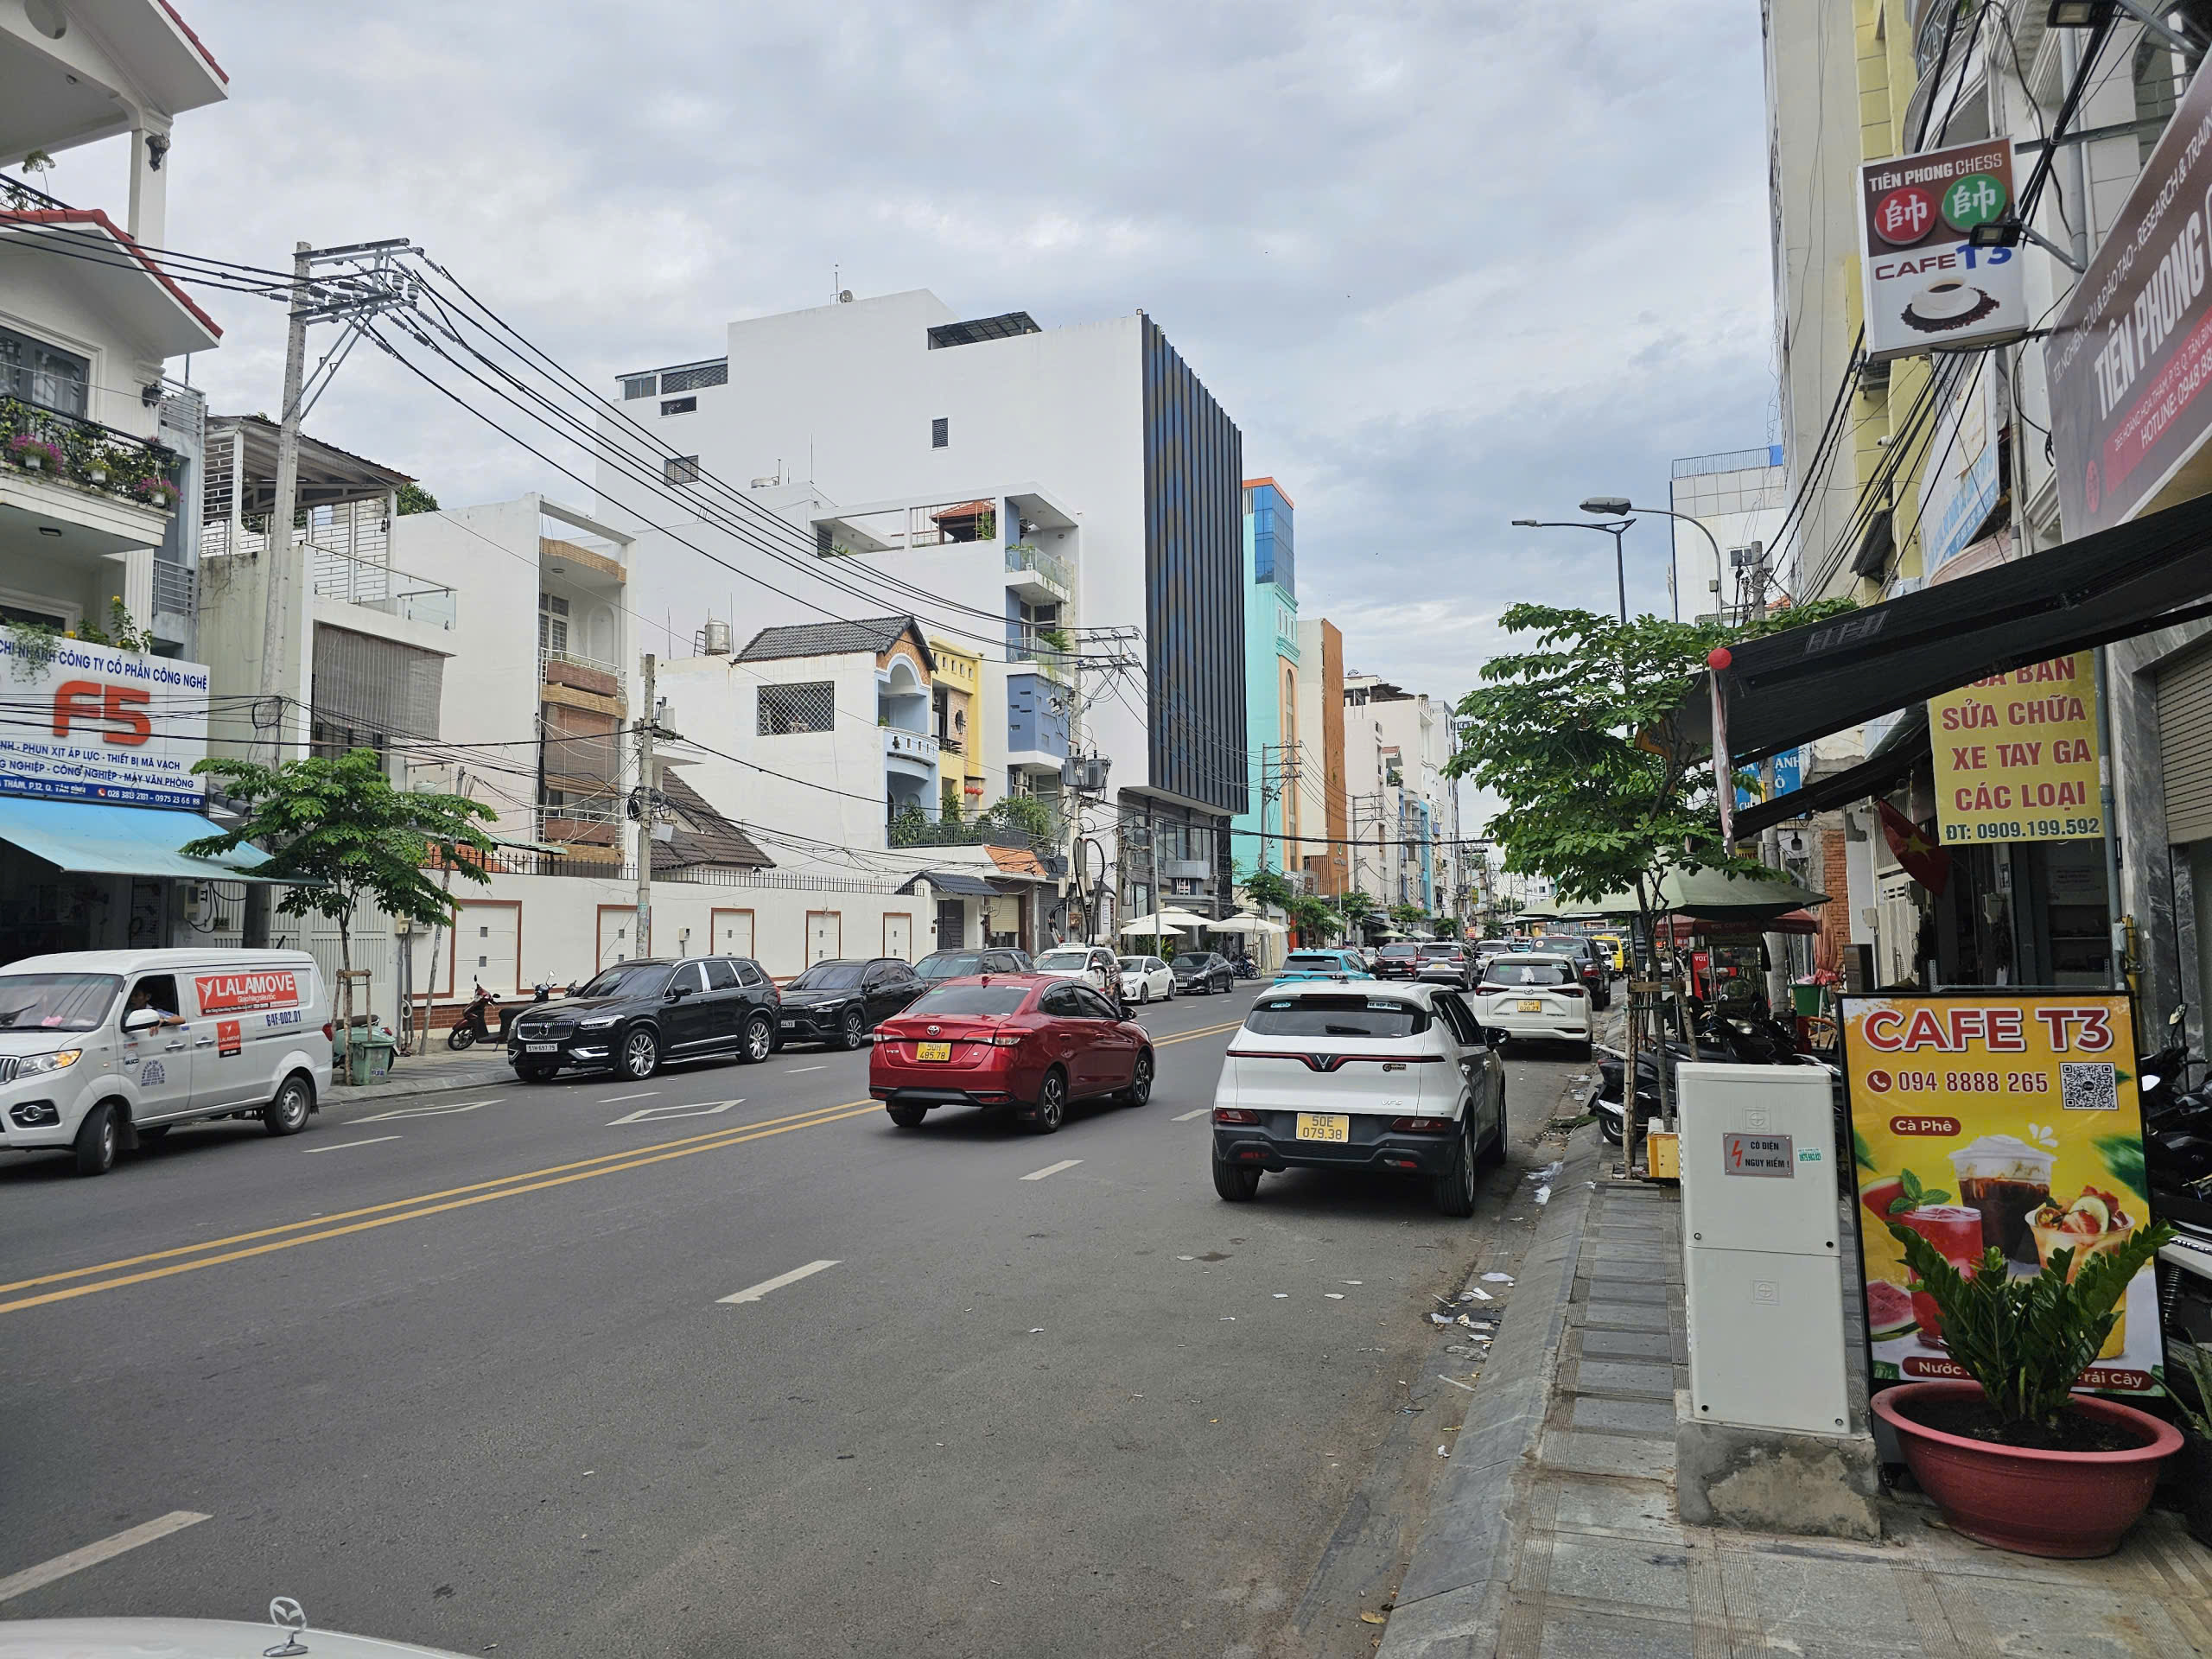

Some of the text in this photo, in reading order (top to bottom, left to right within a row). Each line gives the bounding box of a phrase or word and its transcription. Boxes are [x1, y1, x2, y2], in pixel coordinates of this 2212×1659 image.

[1869, 153, 2003, 193] TIÊN PHONG CHESS
[2117, 244, 2134, 283] TẠO
[2137, 168, 2179, 252] RESEARCH
[2178, 157, 2187, 185] &
[1875, 252, 1957, 281] CAFE
[2094, 211, 2205, 421] TIÊN PHONG
[2177, 363, 2201, 405] 0948
[59, 649, 91, 669] CÔNG
[93, 657, 105, 671] TY
[153, 666, 181, 685] CÔNG
[183, 674, 207, 693] NGHỆ
[53, 679, 152, 747] F5
[1942, 694, 2088, 731] SỬA CHỮA
[22, 742, 48, 755] PHUN
[51, 745, 67, 759] XỊT
[68, 746, 80, 759] ÁP
[83, 750, 100, 762] LỰC
[106, 753, 130, 765] THIẾT
[130, 756, 138, 767] BỊ
[156, 760, 181, 771] VẠCH
[1951, 738, 2093, 772] XE TAY GA
[10, 760, 45, 773] NGHIỆP
[53, 764, 82, 777] CÔNG
[165, 776, 194, 789] PHÒNG
[155, 795, 171, 804] 0975
[1955, 780, 2087, 812] CÁC LOẠI
[1945, 817, 2101, 841] ĐT: 0909.199.592
[215, 974, 295, 997] LALAMOVE
[1863, 1007, 2113, 1052] CAFE T3
[1897, 1071, 2049, 1093] 094 8888 265
[1302, 1127, 1343, 1140] 079.38
[1311, 1116, 1335, 1128] 50E
[1896, 1118, 1953, 1133] Cà Phê
[1745, 1159, 1764, 1167] NGUY
[1918, 1360, 1961, 1376] Nước
[2111, 1372, 2143, 1387] Cây
